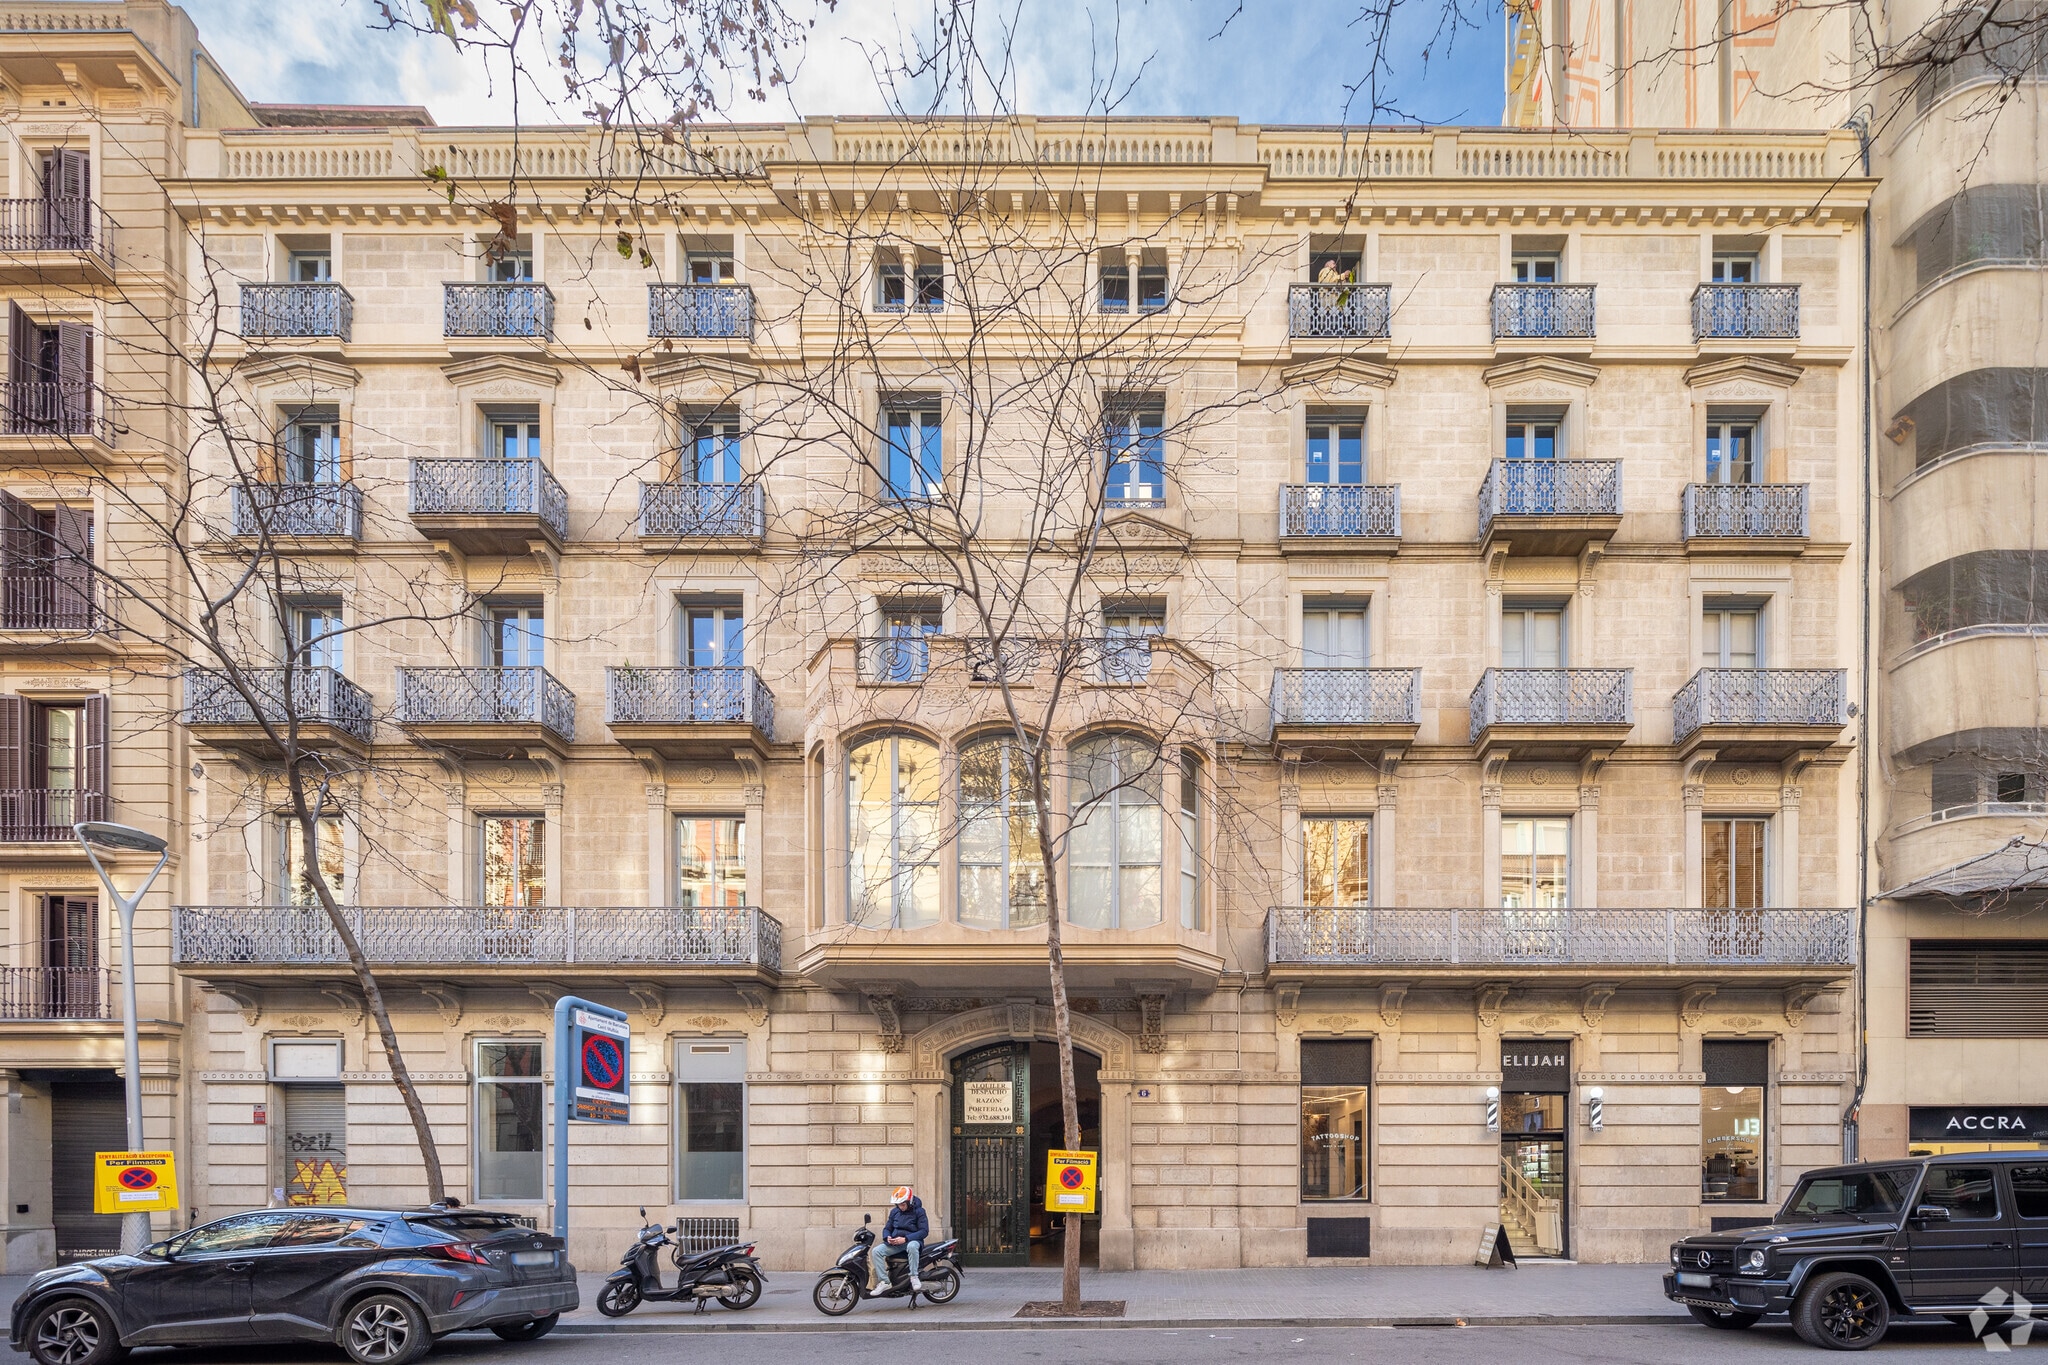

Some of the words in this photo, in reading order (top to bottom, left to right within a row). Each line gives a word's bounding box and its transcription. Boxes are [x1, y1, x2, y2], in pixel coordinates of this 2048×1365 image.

[1503, 1055, 1565, 1067] ELIJAH
[1946, 1116, 2026, 1130] ACCRA
[1311, 1133, 1360, 1141] TATTOOSHOP
[1706, 1135, 1755, 1144] BARBERSHOP
